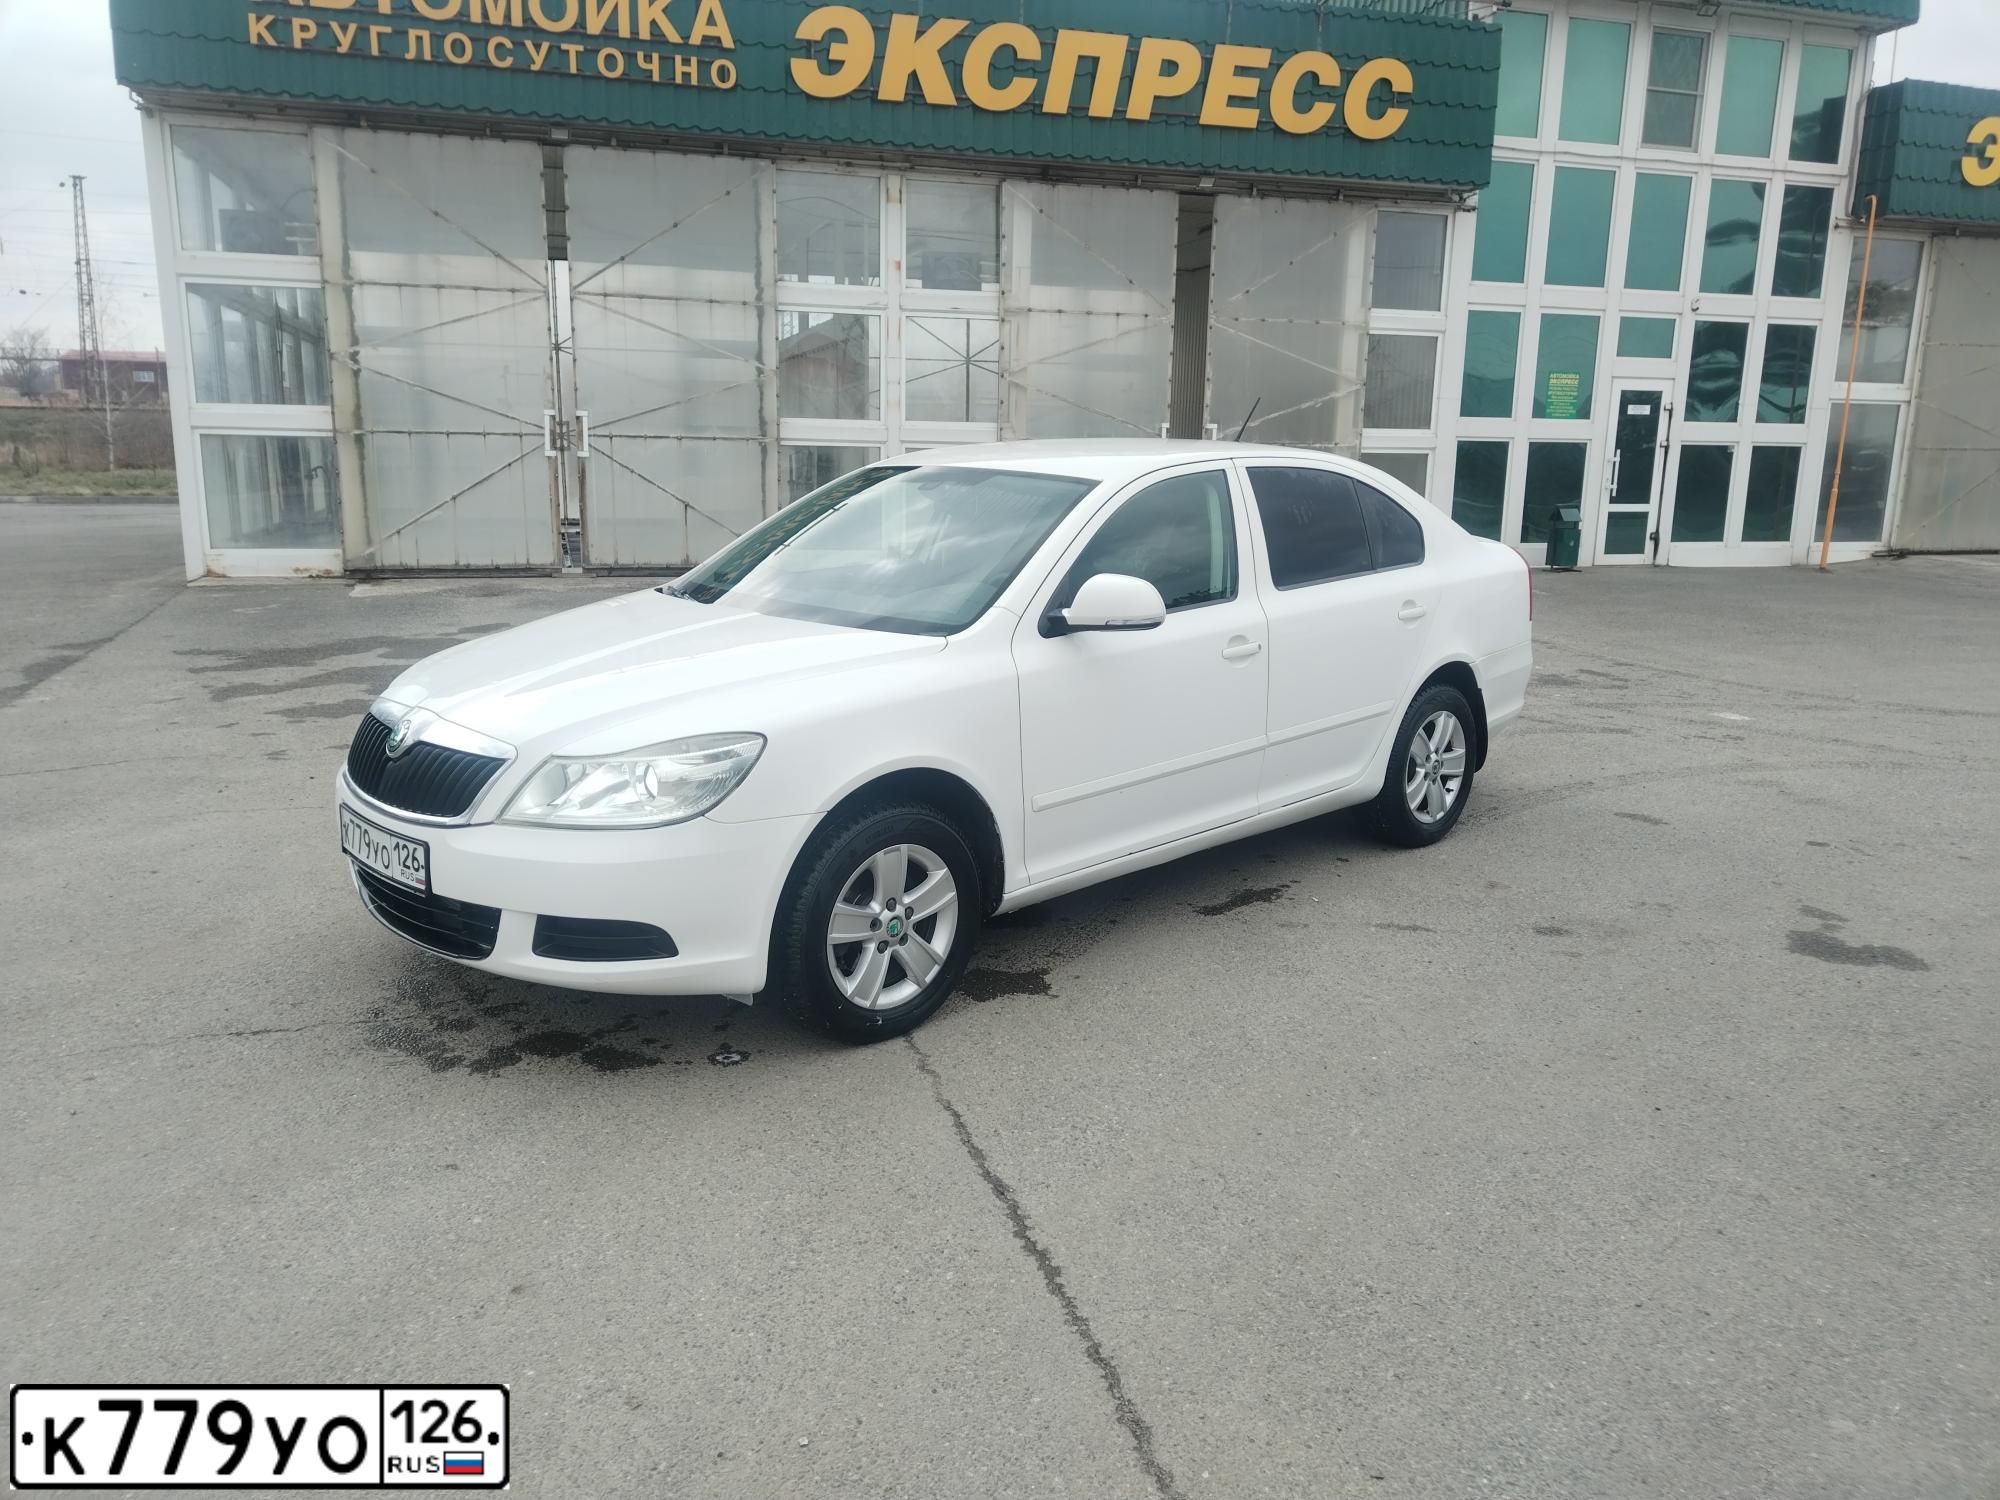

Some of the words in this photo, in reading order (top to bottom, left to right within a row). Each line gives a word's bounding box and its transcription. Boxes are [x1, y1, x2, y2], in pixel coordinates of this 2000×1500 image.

[247, 13, 737, 90] КРУГЛОСУТОЧНО
[790, 5, 1414, 140] ЭКСПРЕСС
[393, 841, 421, 873] 126
[400, 868, 415, 882] RUS
